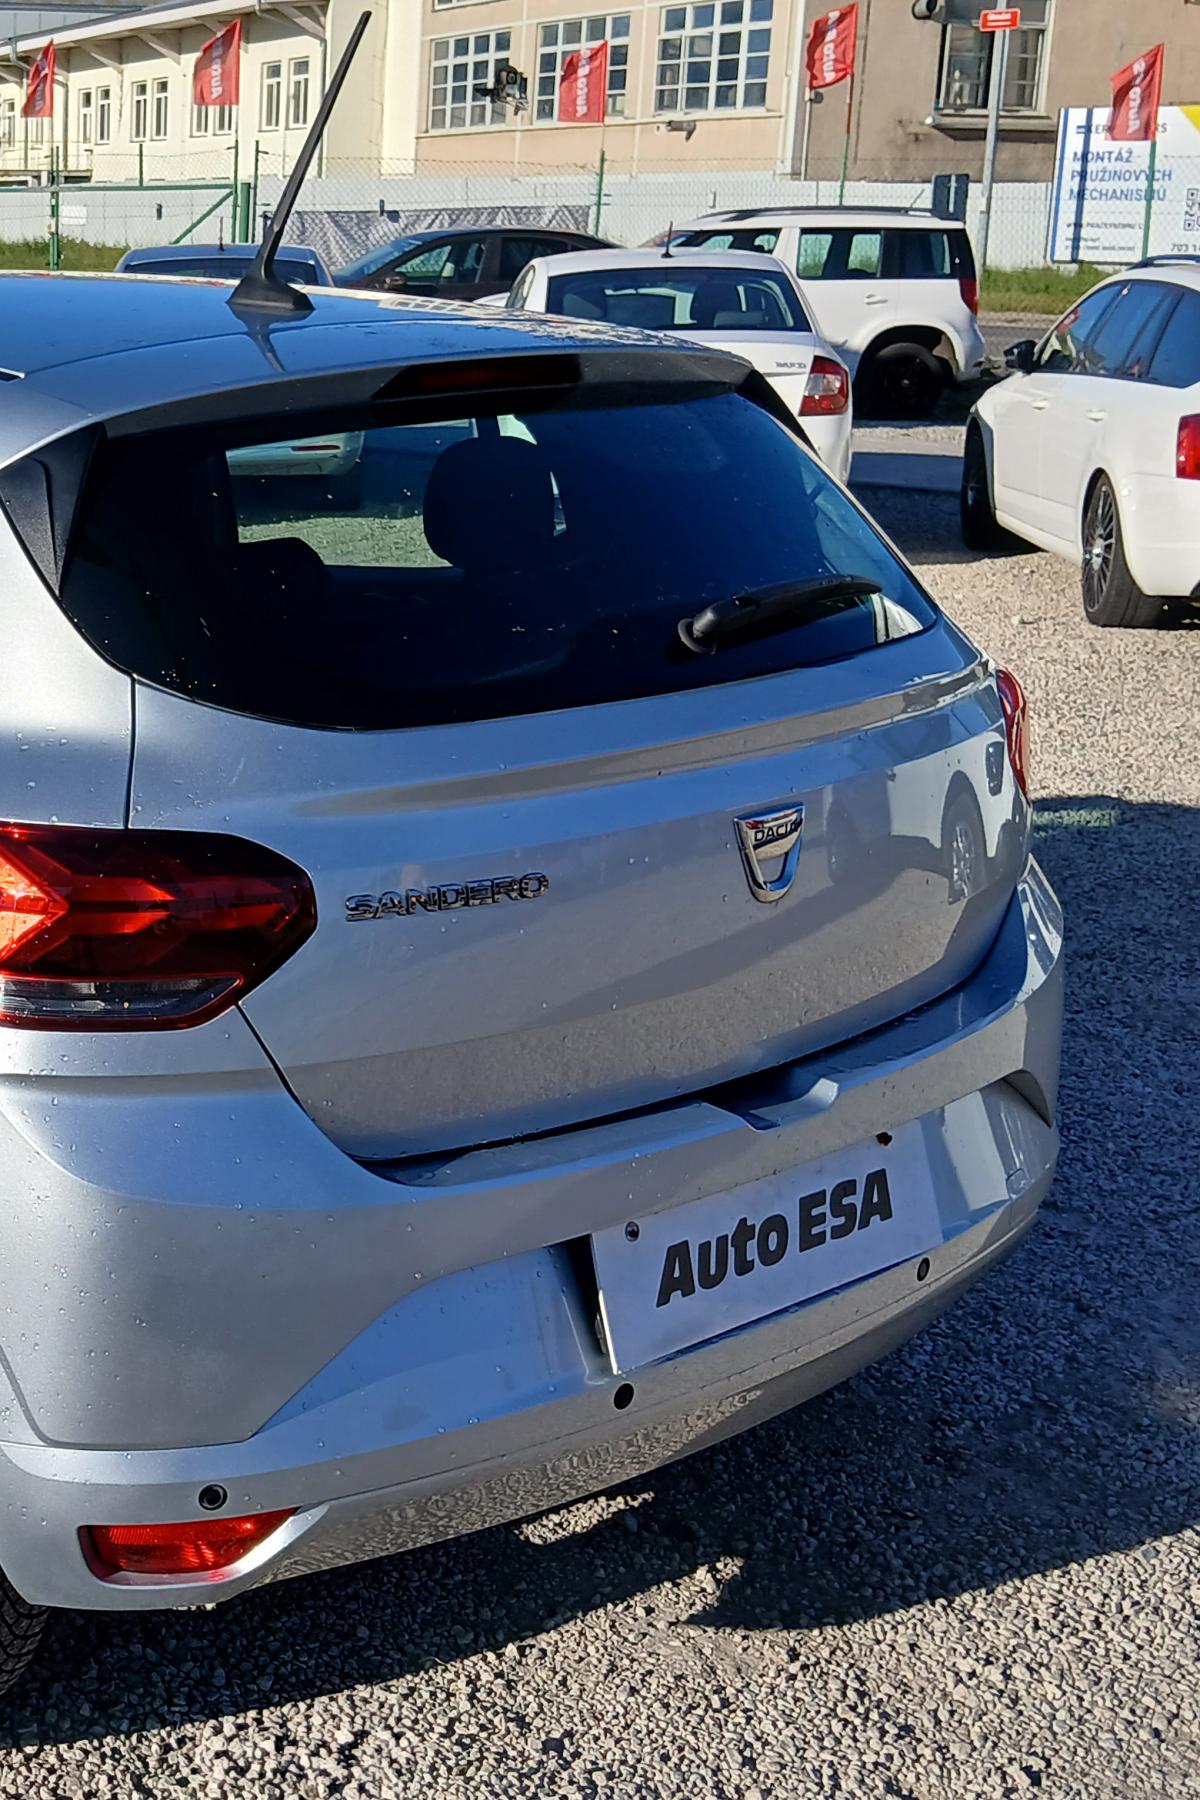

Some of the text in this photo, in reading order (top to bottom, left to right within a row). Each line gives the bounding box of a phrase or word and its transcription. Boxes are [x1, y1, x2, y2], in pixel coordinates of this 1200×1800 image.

[753, 820, 803, 843] DACIA
[345, 871, 550, 922] SANDERO
[655, 1168, 893, 1309] Auto ESA
